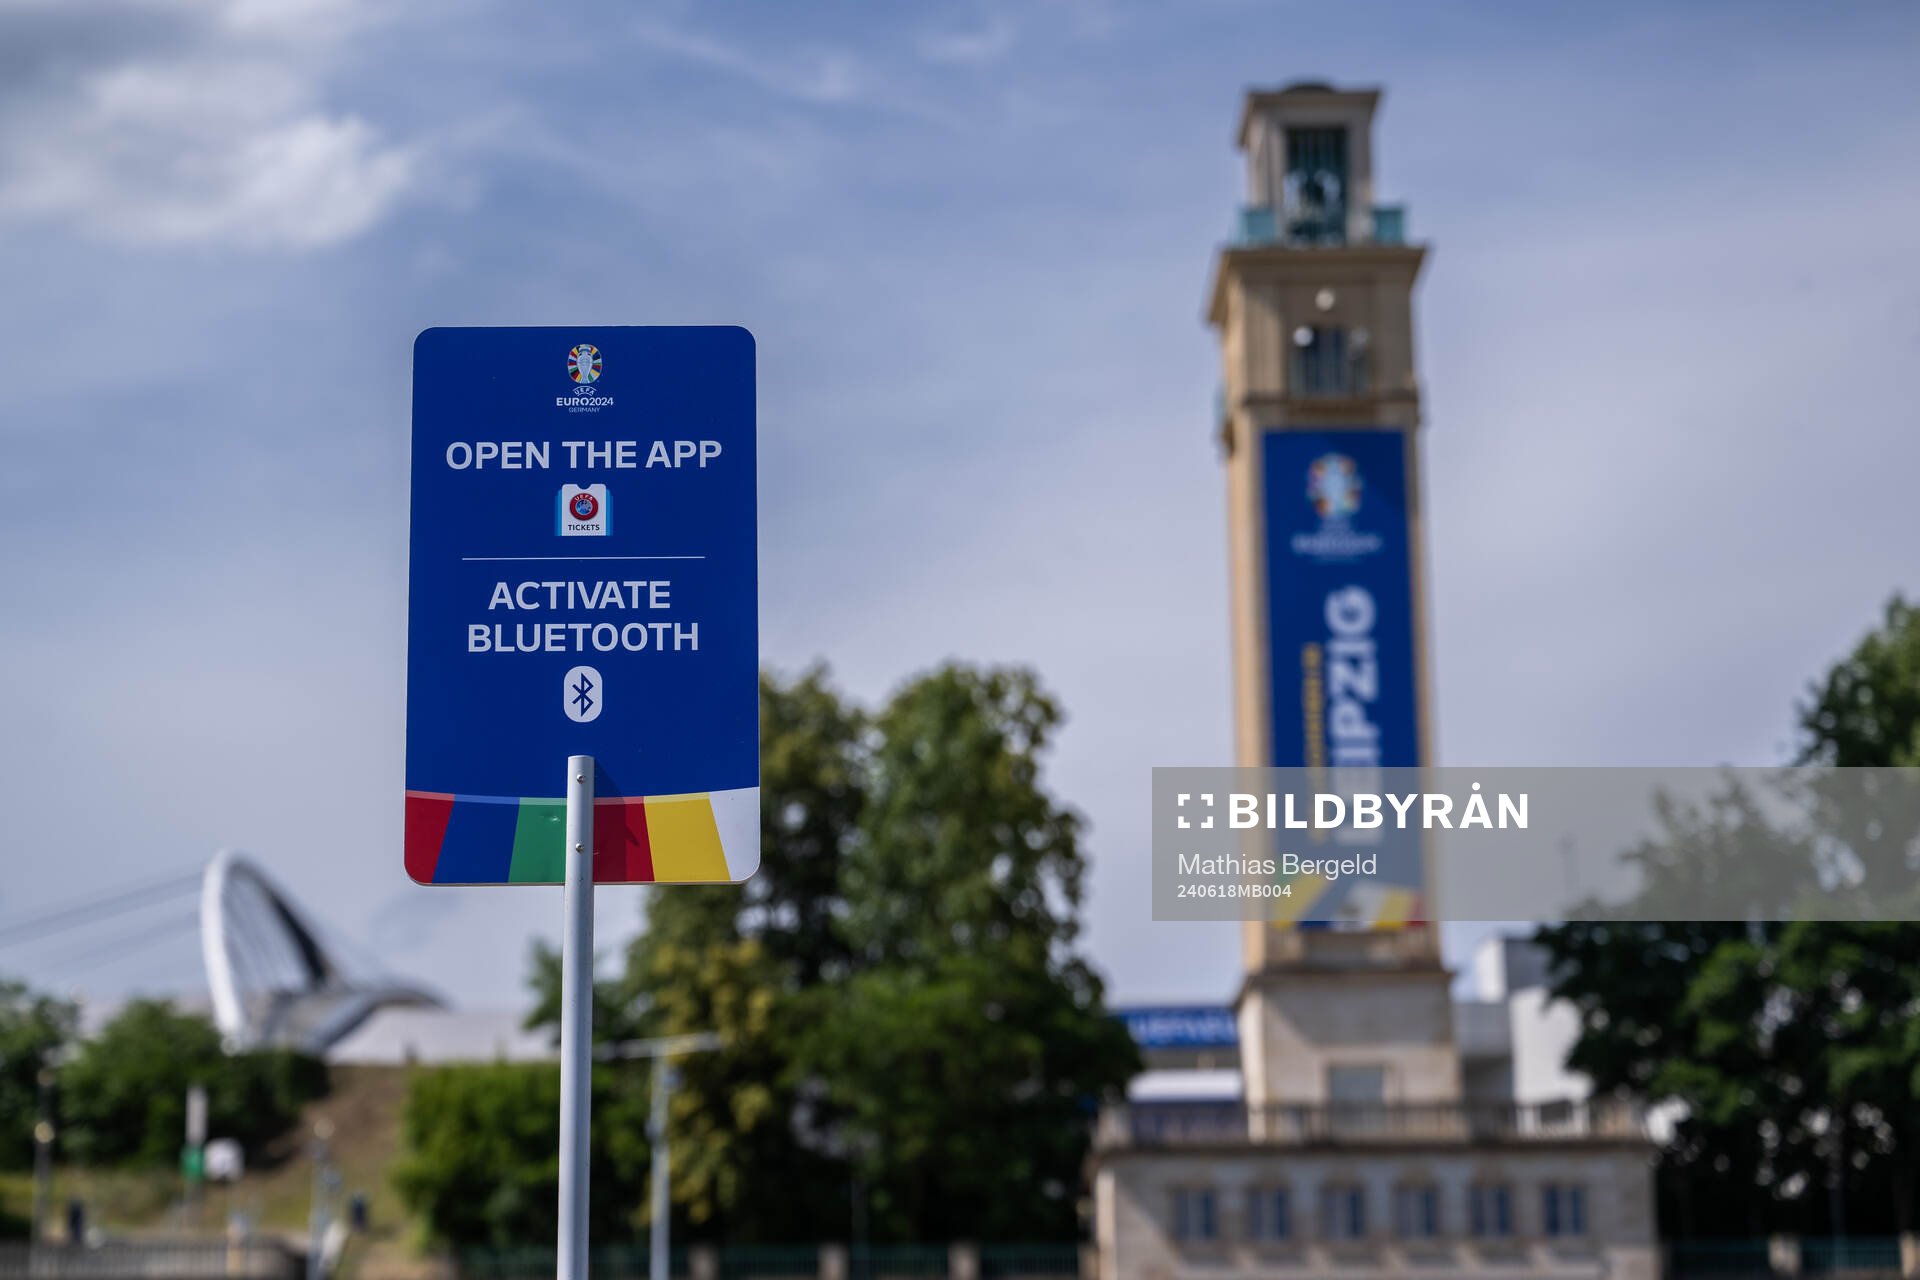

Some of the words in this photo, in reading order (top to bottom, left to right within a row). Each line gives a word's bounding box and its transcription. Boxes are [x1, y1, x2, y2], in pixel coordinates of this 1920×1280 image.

[574, 387, 595, 396] UEFA
[446, 441, 550, 470] OPEN
[562, 441, 637, 469] THE
[645, 440, 723, 469] APP
[488, 581, 671, 610] ACTIVATE
[467, 623, 699, 652] BLUETOOTH
